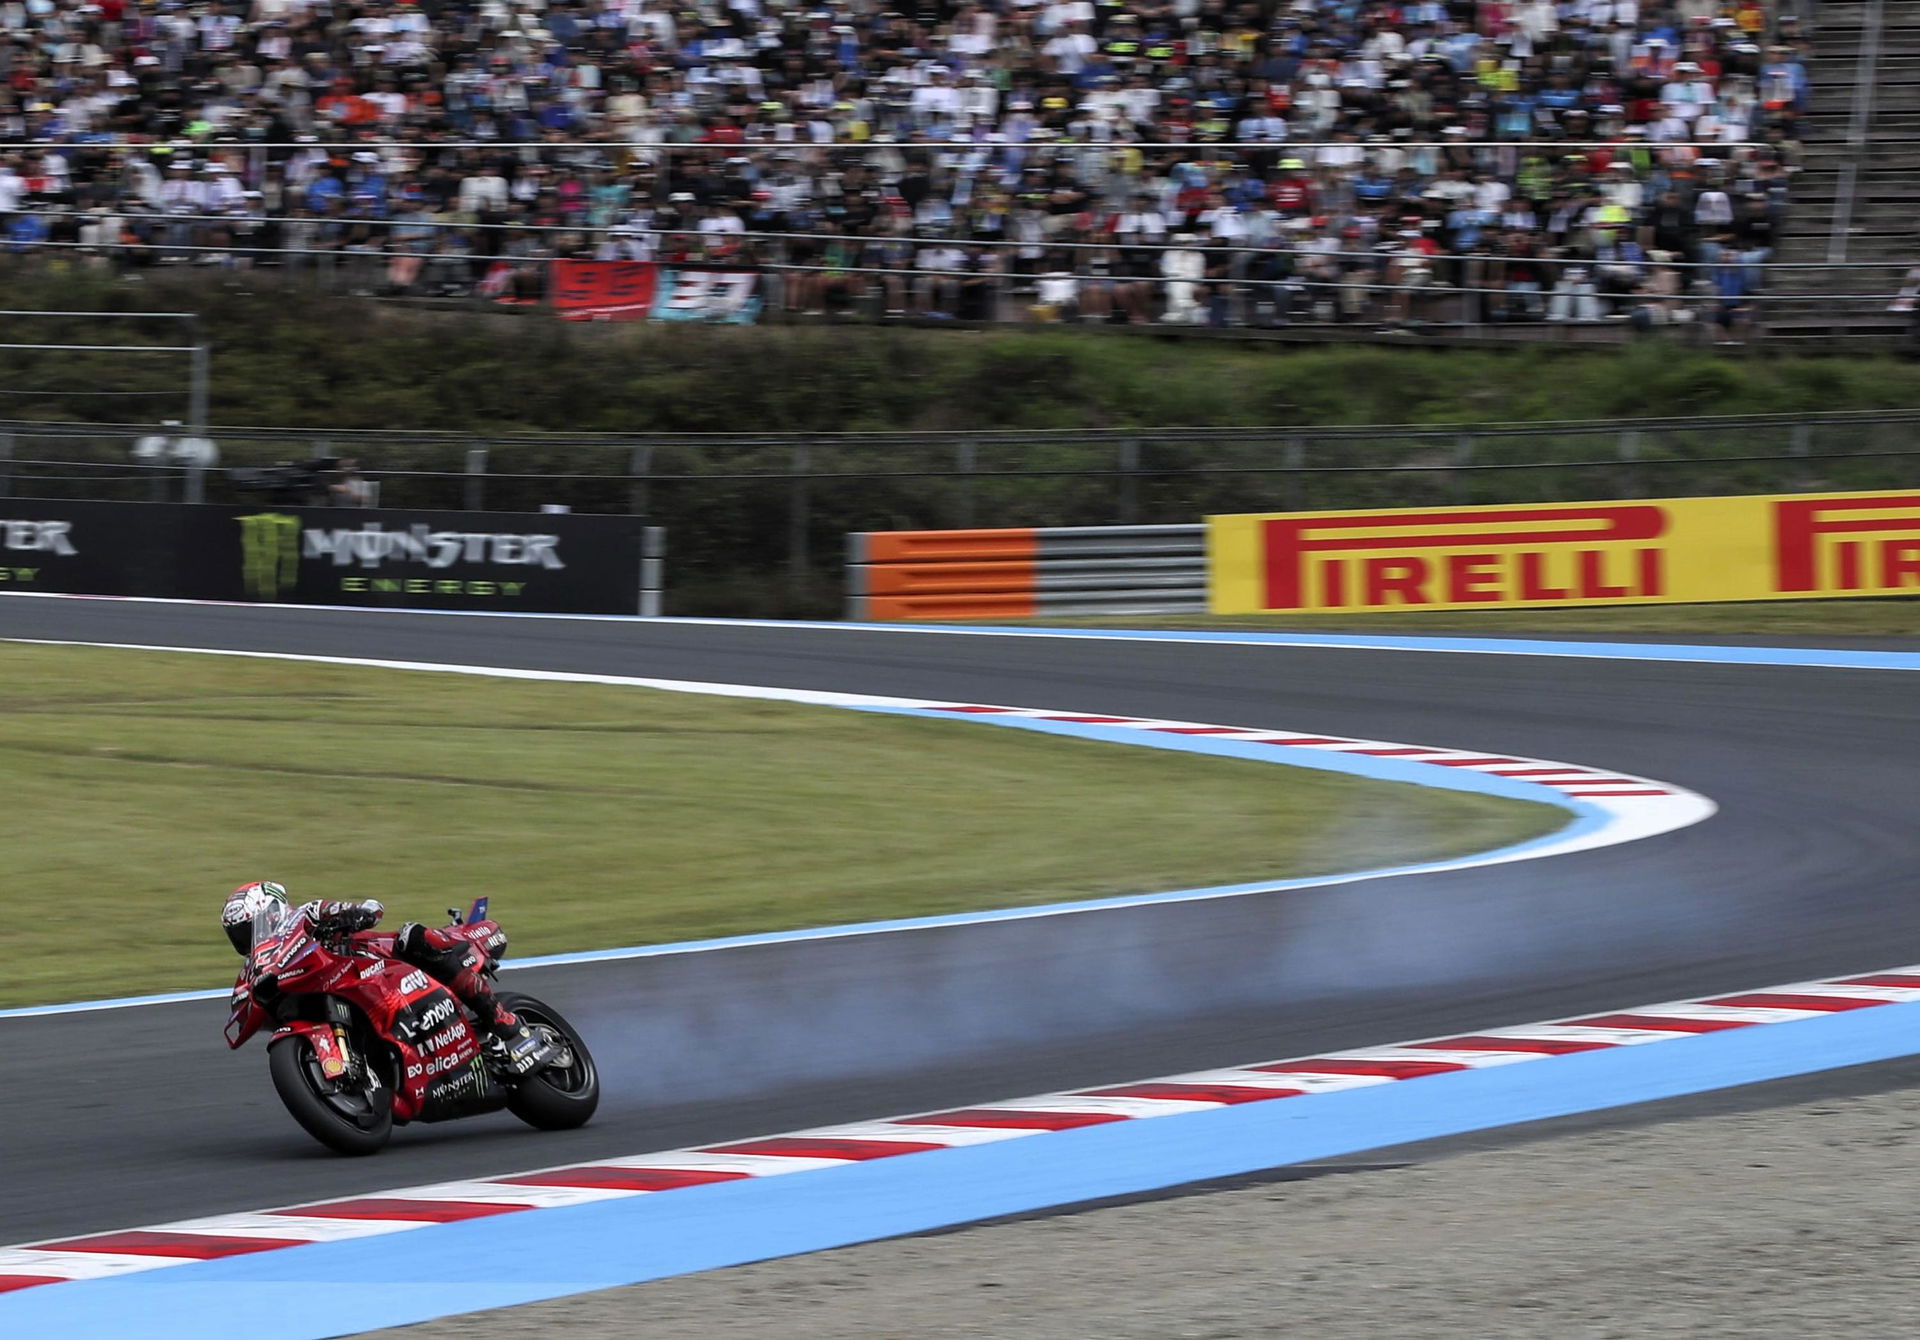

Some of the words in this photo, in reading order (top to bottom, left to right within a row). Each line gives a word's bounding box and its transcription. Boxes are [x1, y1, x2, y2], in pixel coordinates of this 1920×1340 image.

[303, 522, 567, 569] MONSTER
[1261, 504, 1670, 609] PIRELLI
[341, 577, 527, 596] ENERGY
[277, 937, 307, 968] Lenovo
[277, 968, 304, 980] CARRERA
[360, 959, 386, 980] DUCATI
[400, 968, 428, 995] GIVI
[434, 1022, 466, 1051] NetApp
[425, 1052, 459, 1075] elica
[432, 1071, 475, 1099] MONSTER
